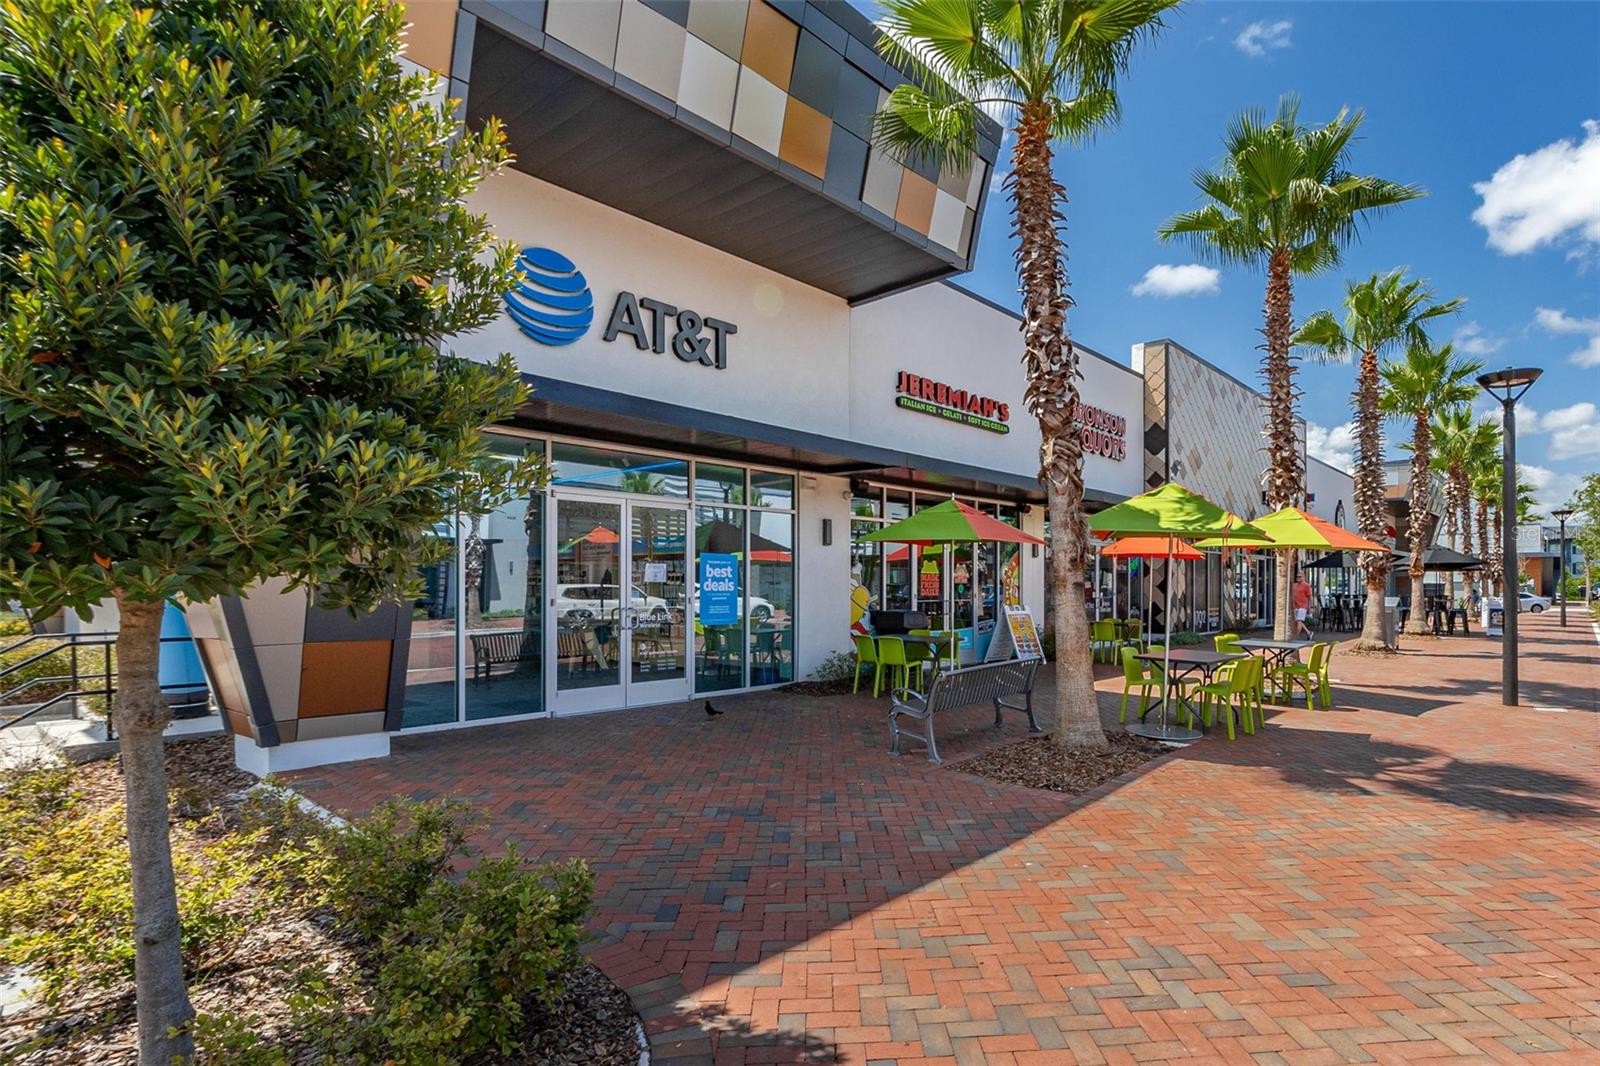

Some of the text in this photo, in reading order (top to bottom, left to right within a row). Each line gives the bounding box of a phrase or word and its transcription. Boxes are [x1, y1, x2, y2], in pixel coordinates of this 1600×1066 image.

[602, 290, 738, 370] AT&T
[896, 369, 1010, 422] JEREMIAH'S
[900, 397, 926, 411] ITALIAN
[926, 405, 937, 414] ICE
[942, 408, 963, 421] GELATI
[967, 415, 981, 426] SOFT
[703, 578, 735, 592] deals
[706, 564, 733, 578] best
